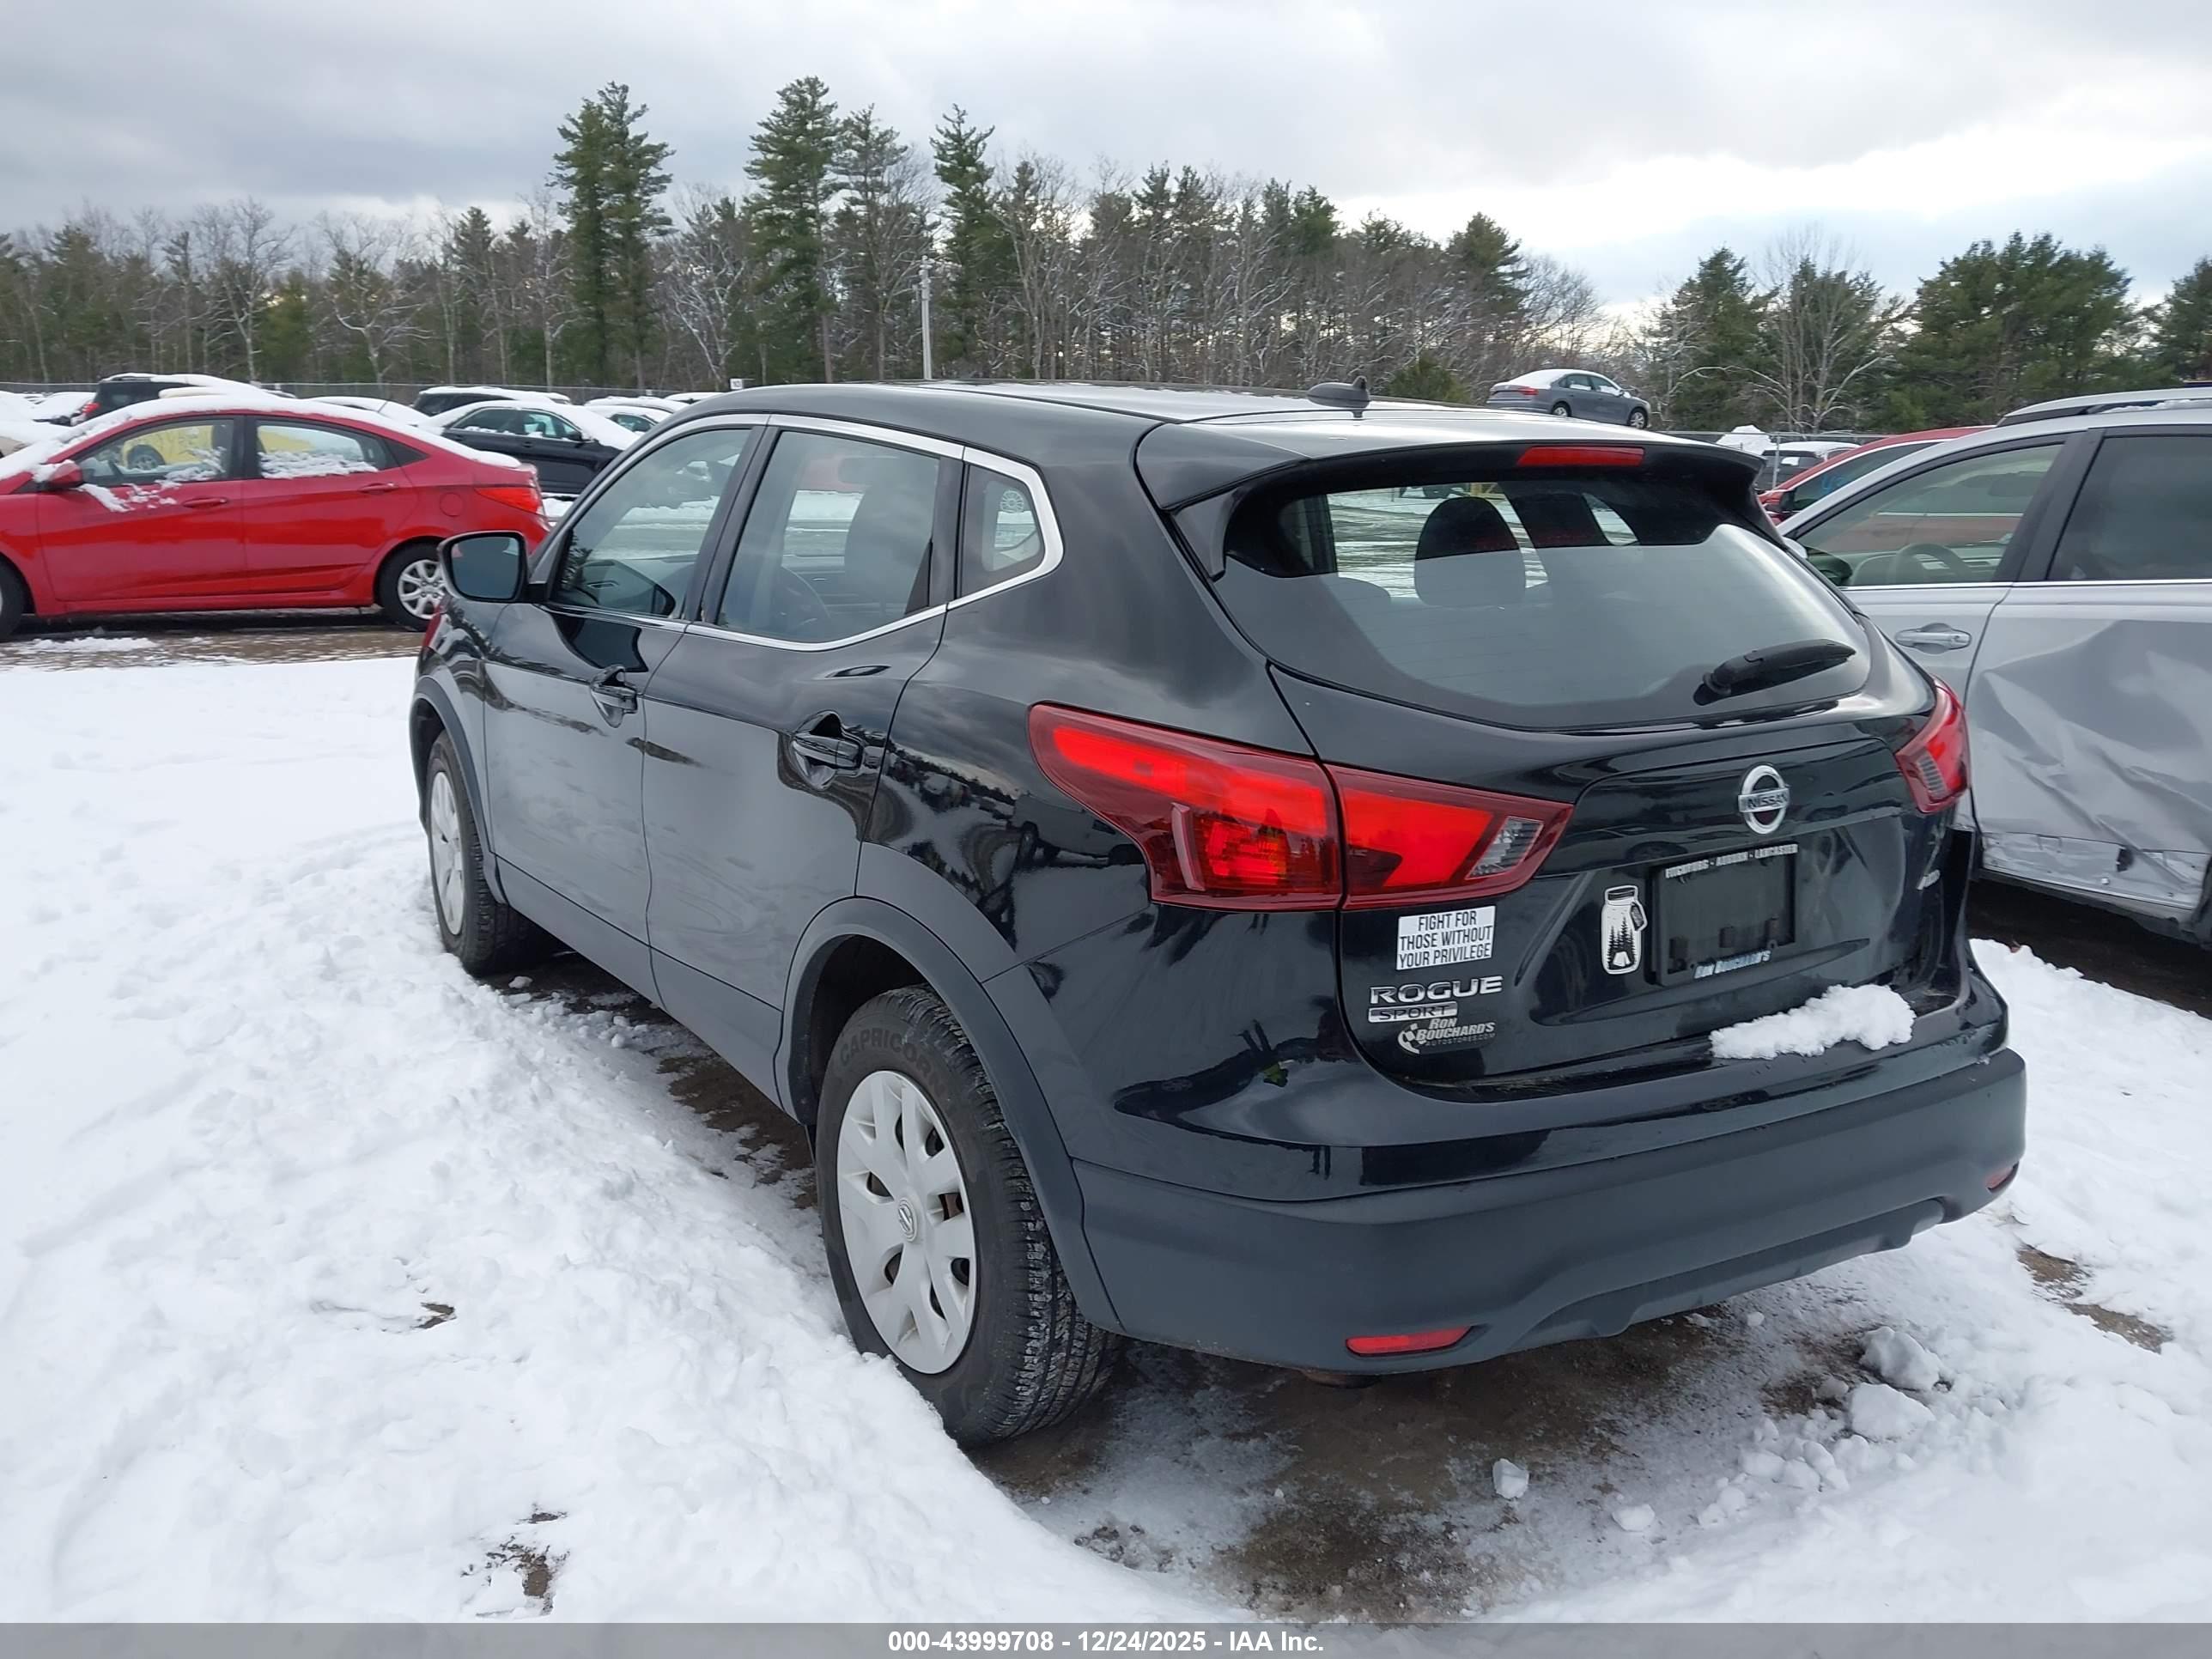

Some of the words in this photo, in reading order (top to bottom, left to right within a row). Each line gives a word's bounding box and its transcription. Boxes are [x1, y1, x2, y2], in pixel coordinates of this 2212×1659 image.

[1419, 914, 1453, 931] FIGHT
[1455, 911, 1476, 927] FOR
[1400, 933, 1437, 951] THOSE
[1442, 926, 1492, 945] WITHOUT
[1400, 951, 1430, 968] YOUR
[1433, 943, 1491, 963] PRIVILEGE
[1370, 975, 1503, 1004] ROGUE
[1379, 1006, 1449, 1020] SPORT
